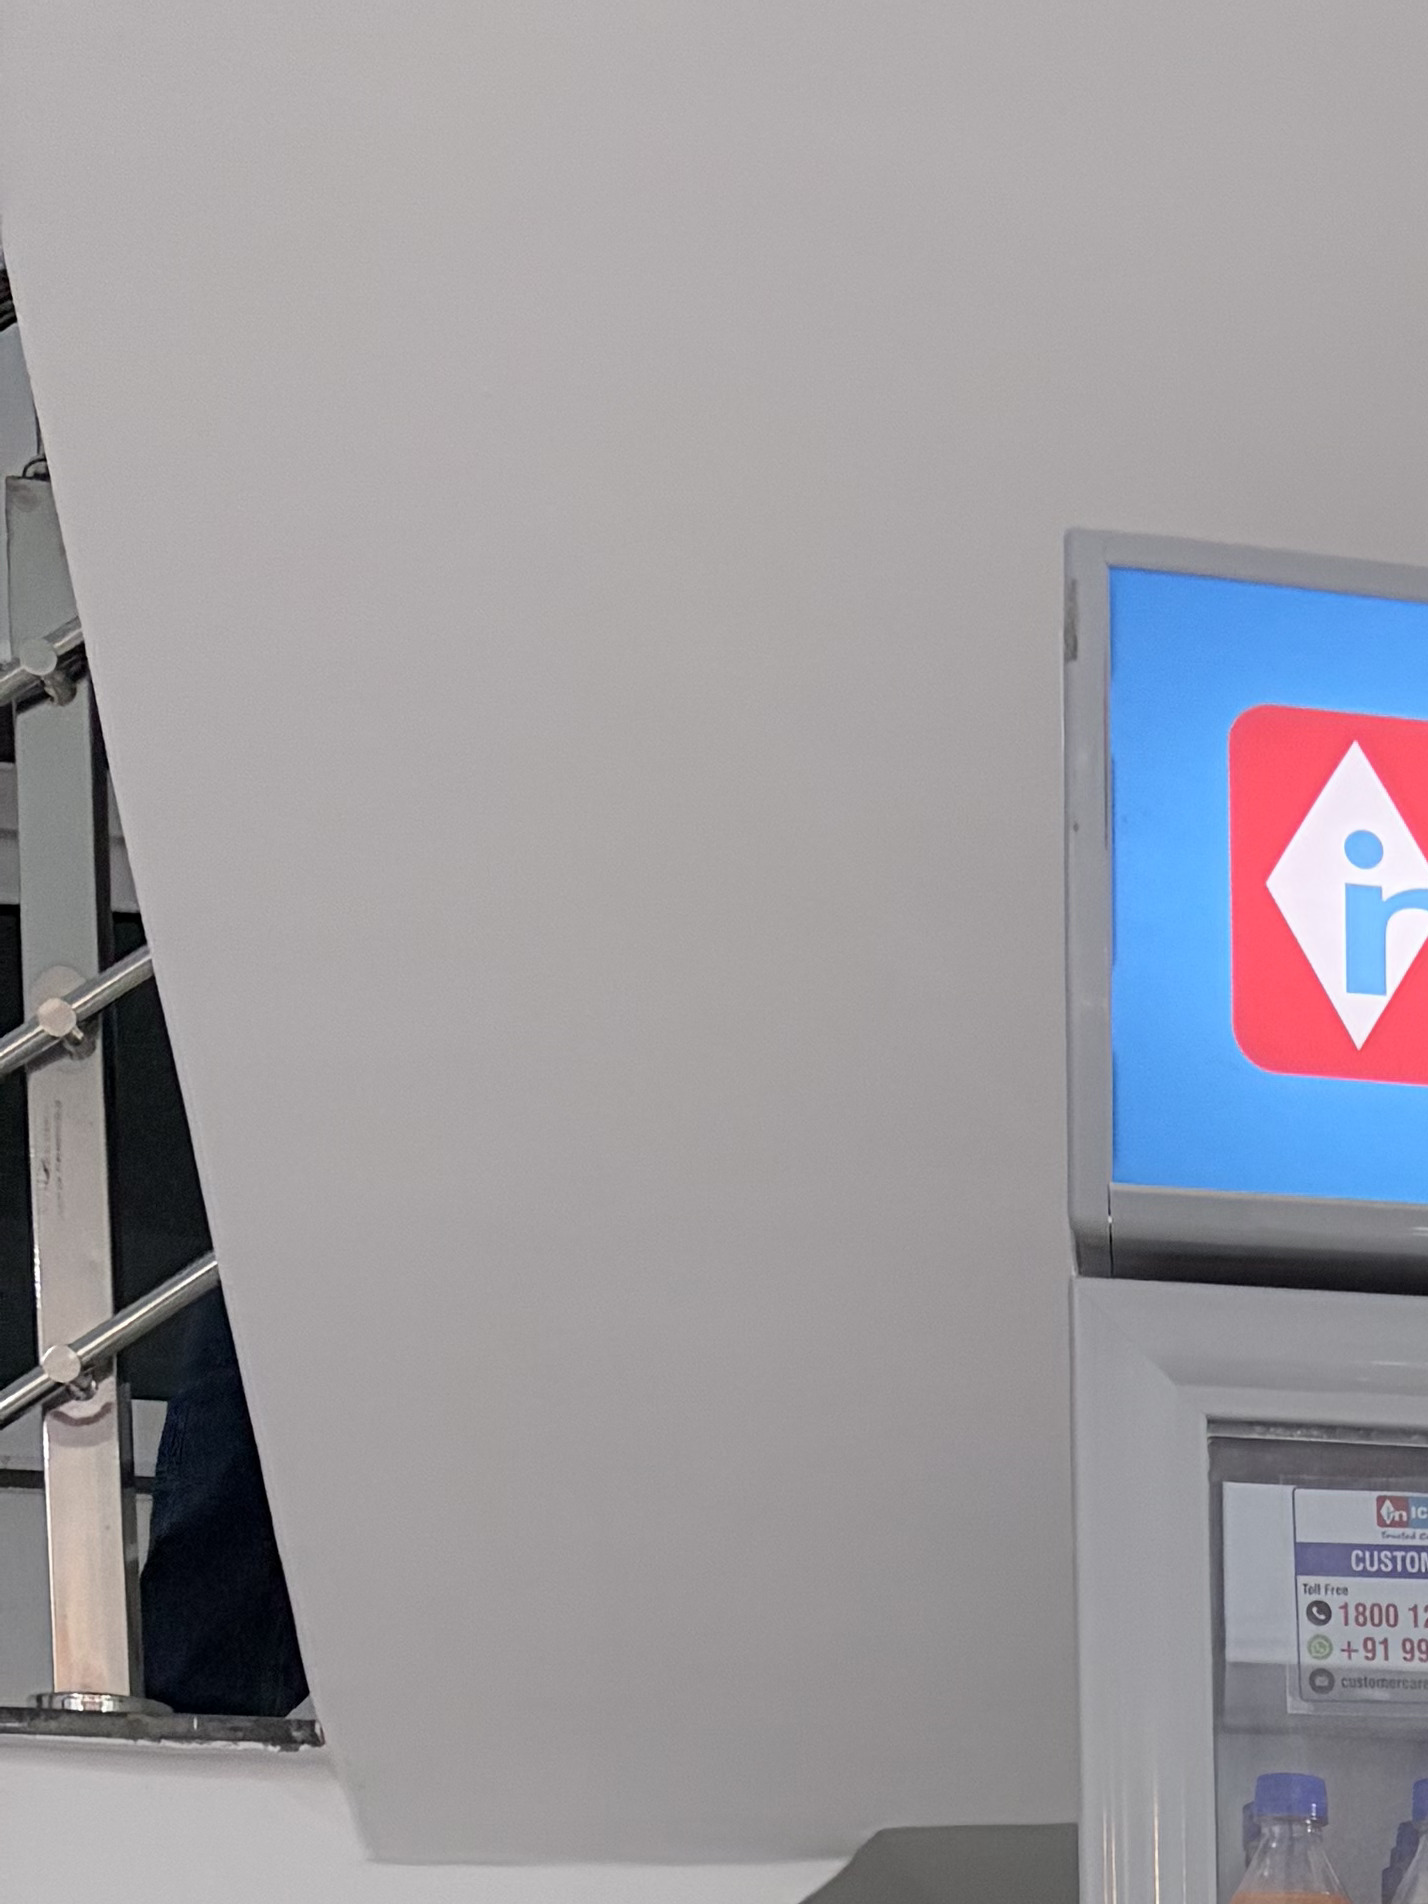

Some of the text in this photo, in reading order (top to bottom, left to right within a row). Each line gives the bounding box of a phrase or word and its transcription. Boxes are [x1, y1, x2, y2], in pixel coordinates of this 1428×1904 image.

[1303, 1583, 1349, 1596] Toll Free
[1338, 1601, 1399, 1628] 1800
[1340, 1636, 1391, 1663] +91
